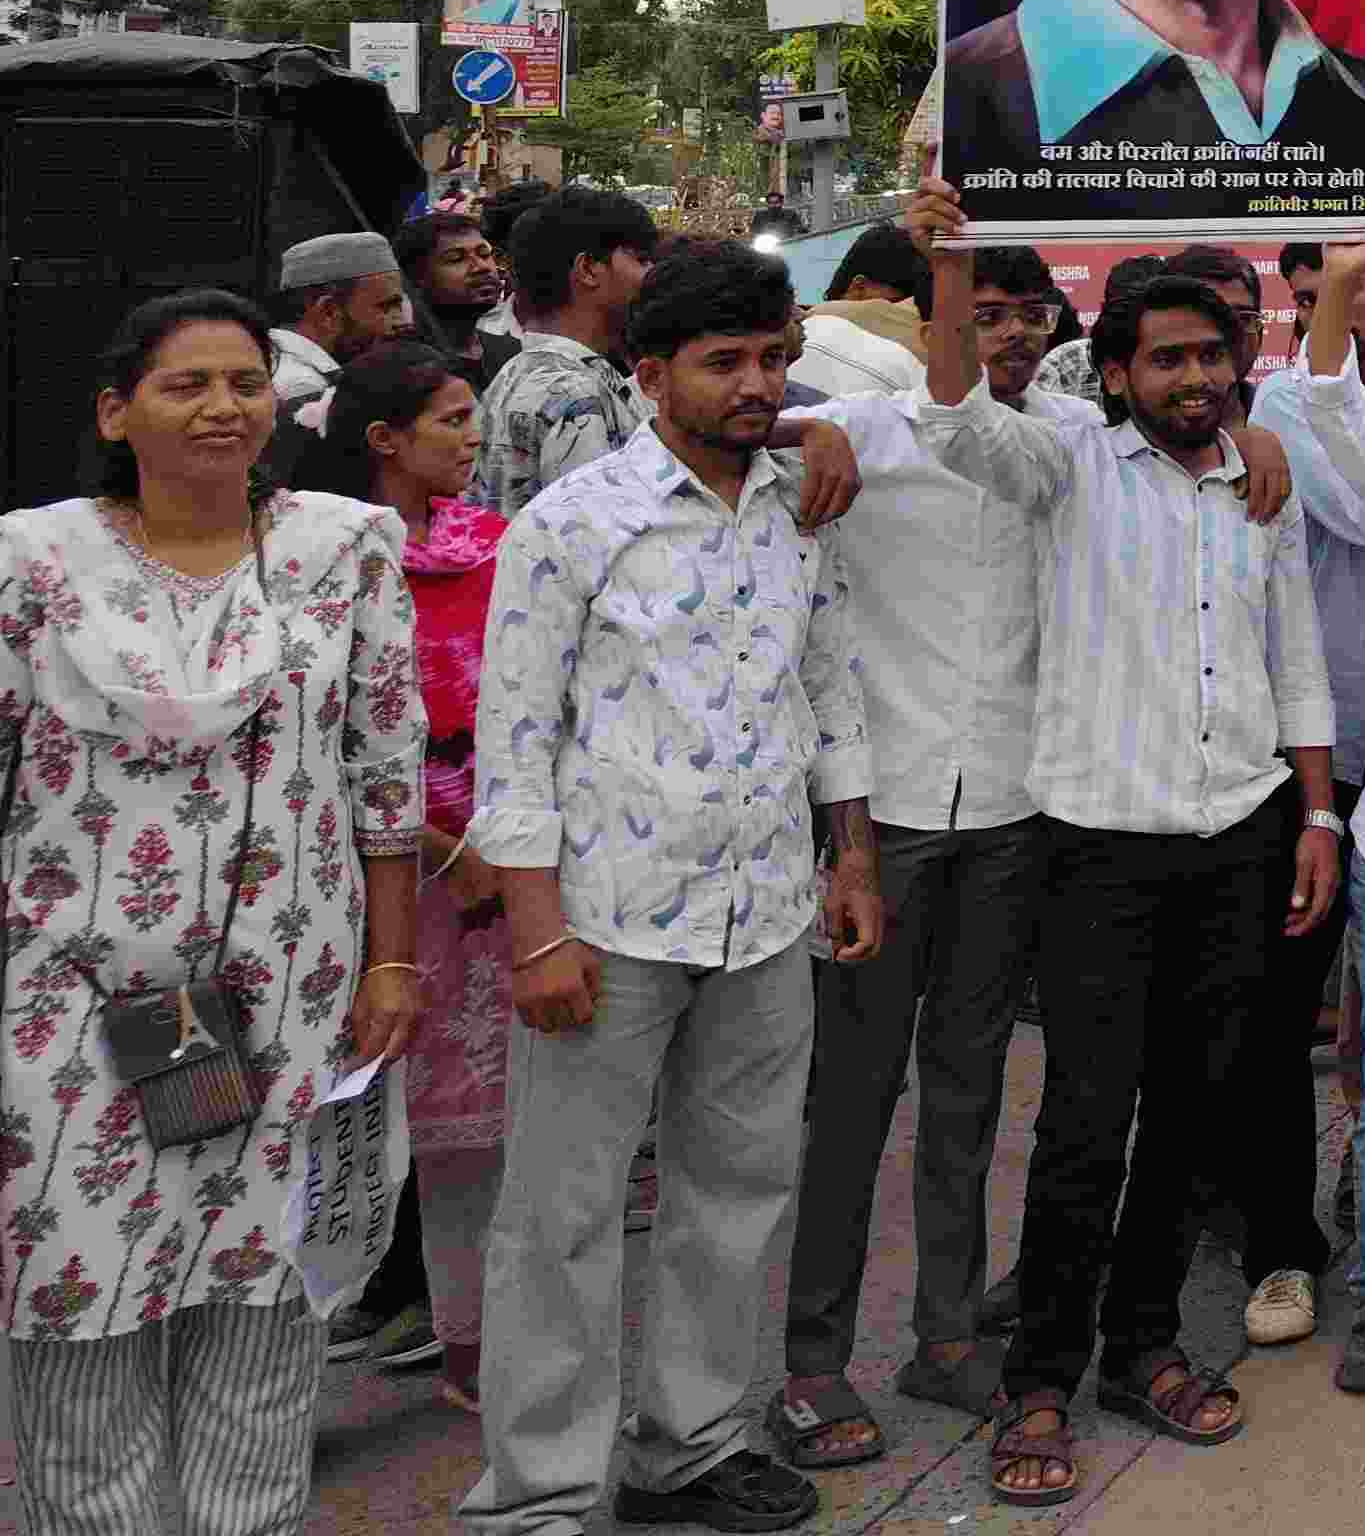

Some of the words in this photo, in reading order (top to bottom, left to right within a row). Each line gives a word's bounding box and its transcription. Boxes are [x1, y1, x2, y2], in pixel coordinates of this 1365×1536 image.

[1078, 141, 1112, 161] और
[1118, 141, 1188, 161] पिस्तौल
[1194, 143, 1240, 162] क्रांति
[1245, 143, 1279, 162] नहीं
[962, 168, 1017, 189] क्रांति
[1022, 168, 1052, 189] की
[1057, 172, 1121, 189] तलवार
[1126, 168, 1185, 189] विचारों
[1190, 168, 1217, 188] की
[1264, 172, 1289, 188] पर
[1328, 167, 1365, 188] होती
[1312, 198, 1348, 212] भगत
